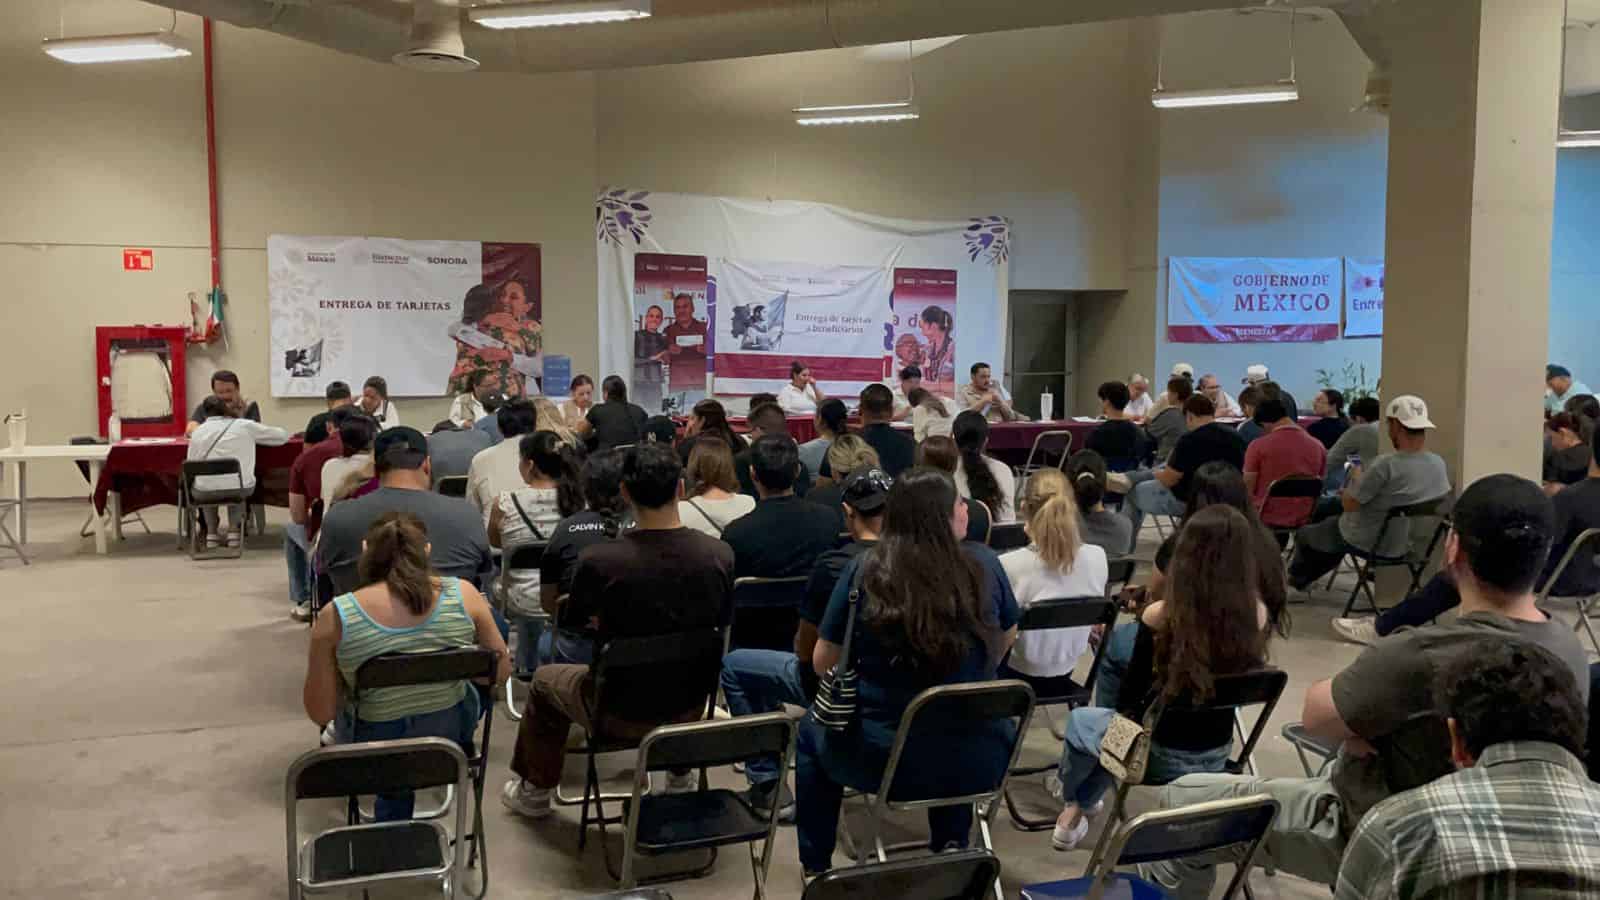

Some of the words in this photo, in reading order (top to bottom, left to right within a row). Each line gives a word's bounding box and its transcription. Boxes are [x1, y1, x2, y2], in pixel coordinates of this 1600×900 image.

[427, 256, 468, 265] SONORA
[1312, 275, 1329, 287] DE
[1234, 288, 1330, 312] MÉXICO
[320, 301, 372, 309] ENTREGA
[377, 302, 392, 310] DE
[397, 302, 451, 311] TARJETAS
[796, 313, 828, 324] Entrega
[569, 522, 598, 532] CALVIN
